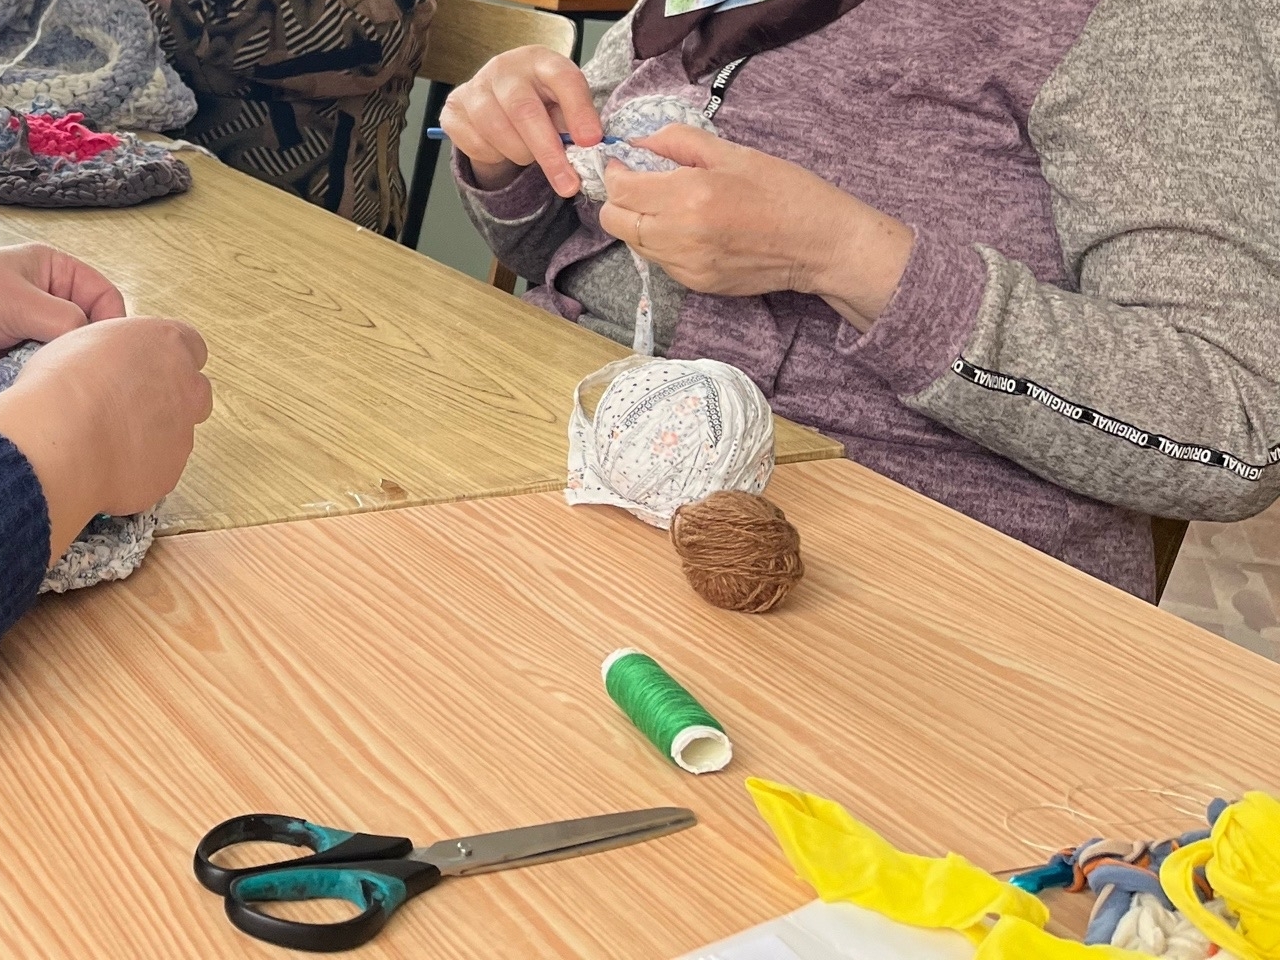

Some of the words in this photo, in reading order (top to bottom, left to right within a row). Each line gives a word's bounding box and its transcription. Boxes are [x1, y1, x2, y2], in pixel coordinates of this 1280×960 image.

[703, 95, 722, 119] ORIG
[973, 368, 1016, 393] ORIGINAL
[1026, 382, 1083, 420] ORIGINAL
[1092, 412, 1149, 446] ORIGINAL
[1158, 437, 1211, 463] ORIGINAL
[1222, 454, 1263, 480] IGINAL
